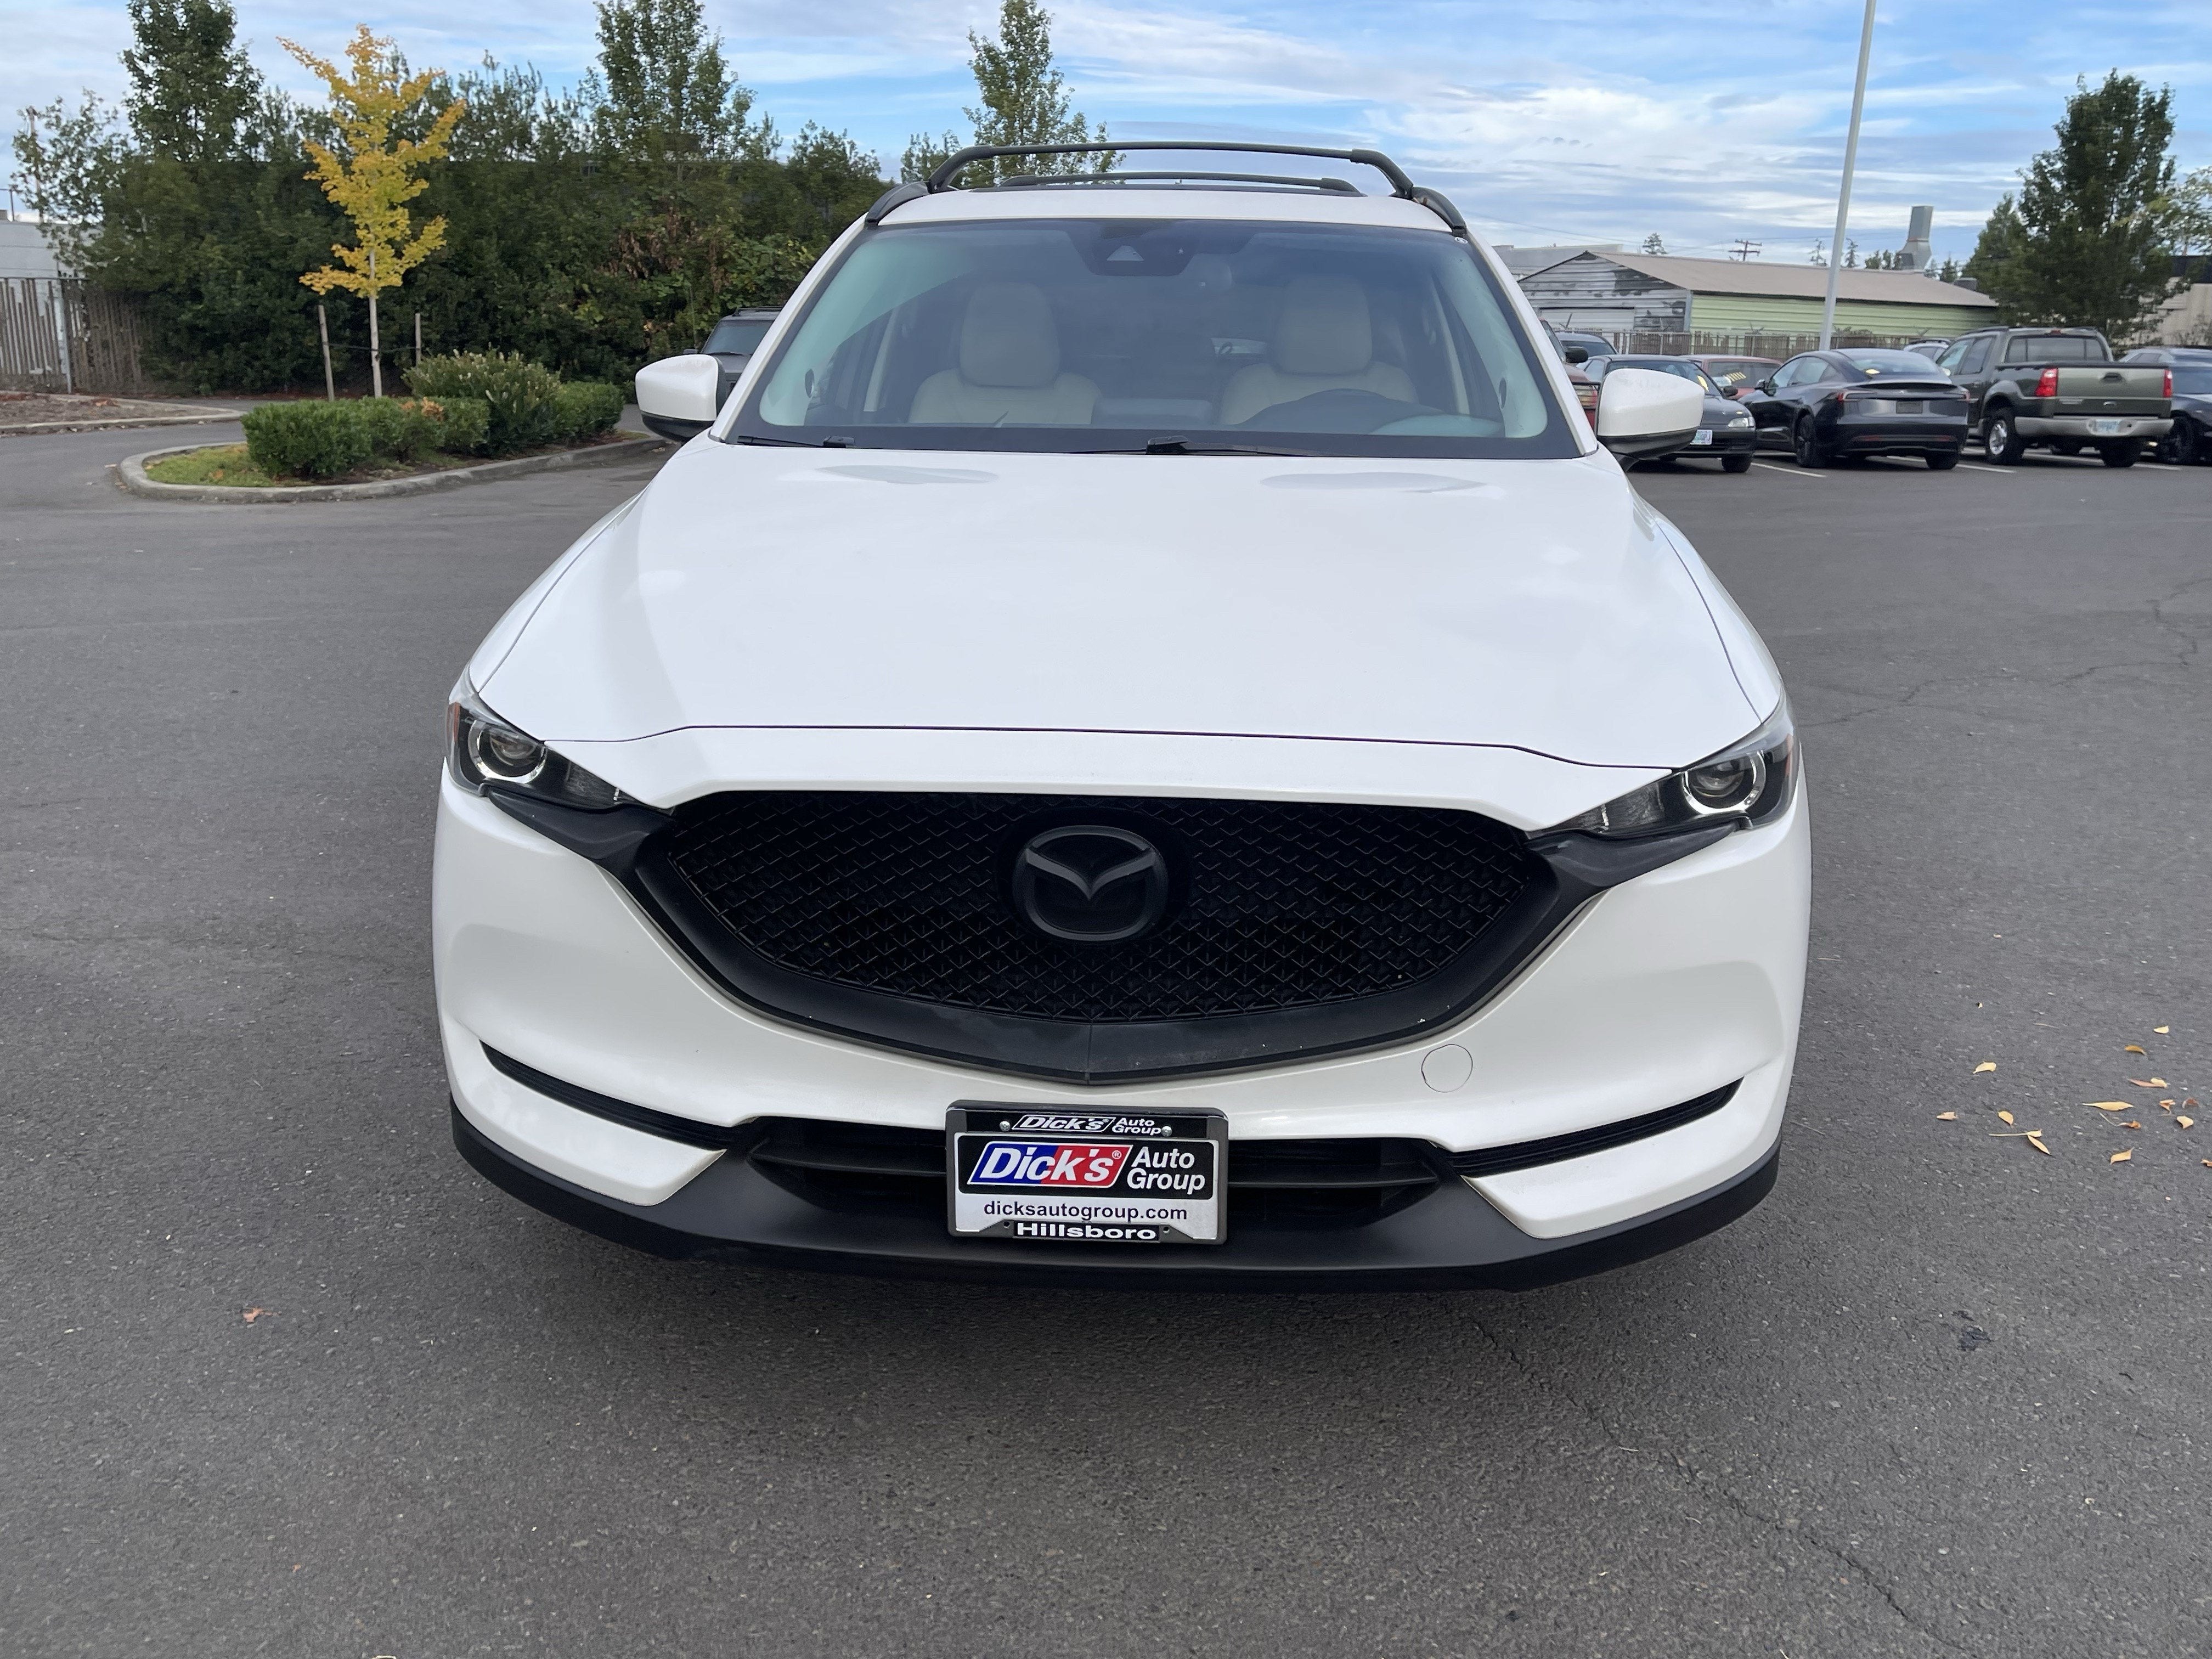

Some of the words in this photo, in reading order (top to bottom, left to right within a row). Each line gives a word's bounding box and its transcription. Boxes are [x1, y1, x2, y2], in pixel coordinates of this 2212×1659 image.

[1111, 1125, 1161, 1136] Group
[1115, 1118, 1155, 1127] Auto
[1131, 1147, 1195, 1169] Auto
[1127, 1168, 1206, 1195] Group
[984, 1201, 1187, 1222] dicksautogroup.com
[1017, 1223, 1156, 1240] Hillsboro
